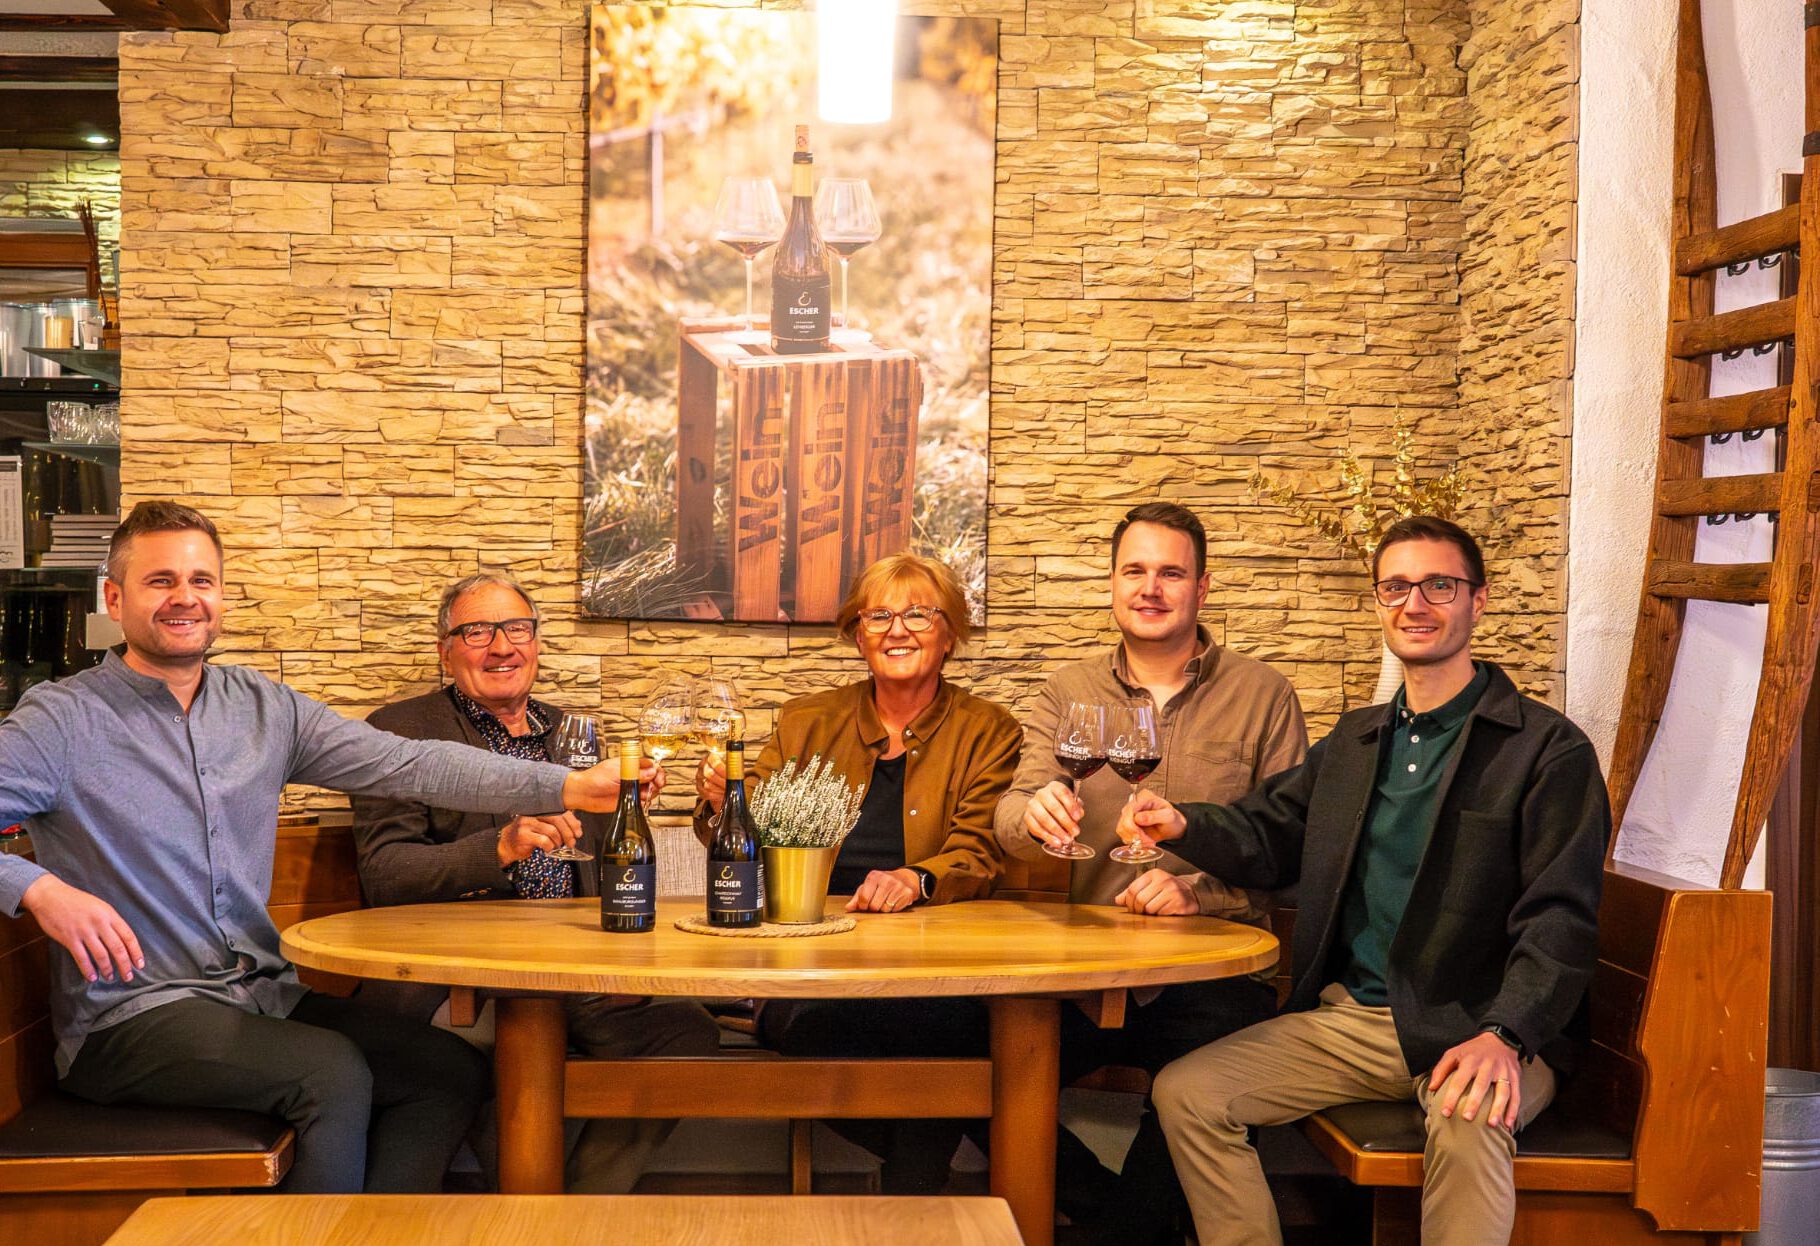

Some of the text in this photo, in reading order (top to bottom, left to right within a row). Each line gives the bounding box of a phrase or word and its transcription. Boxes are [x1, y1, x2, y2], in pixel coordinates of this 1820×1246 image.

[789, 307, 819, 315] ESCHER
[864, 398, 909, 537] Wein
[800, 401, 844, 546] Wein
[738, 407, 783, 552] Wein
[1060, 743, 1089, 755] ESCHER
[1109, 748, 1137, 758] ESCHER
[615, 883, 644, 891] ESCHER
[714, 880, 742, 888] ESCHER
